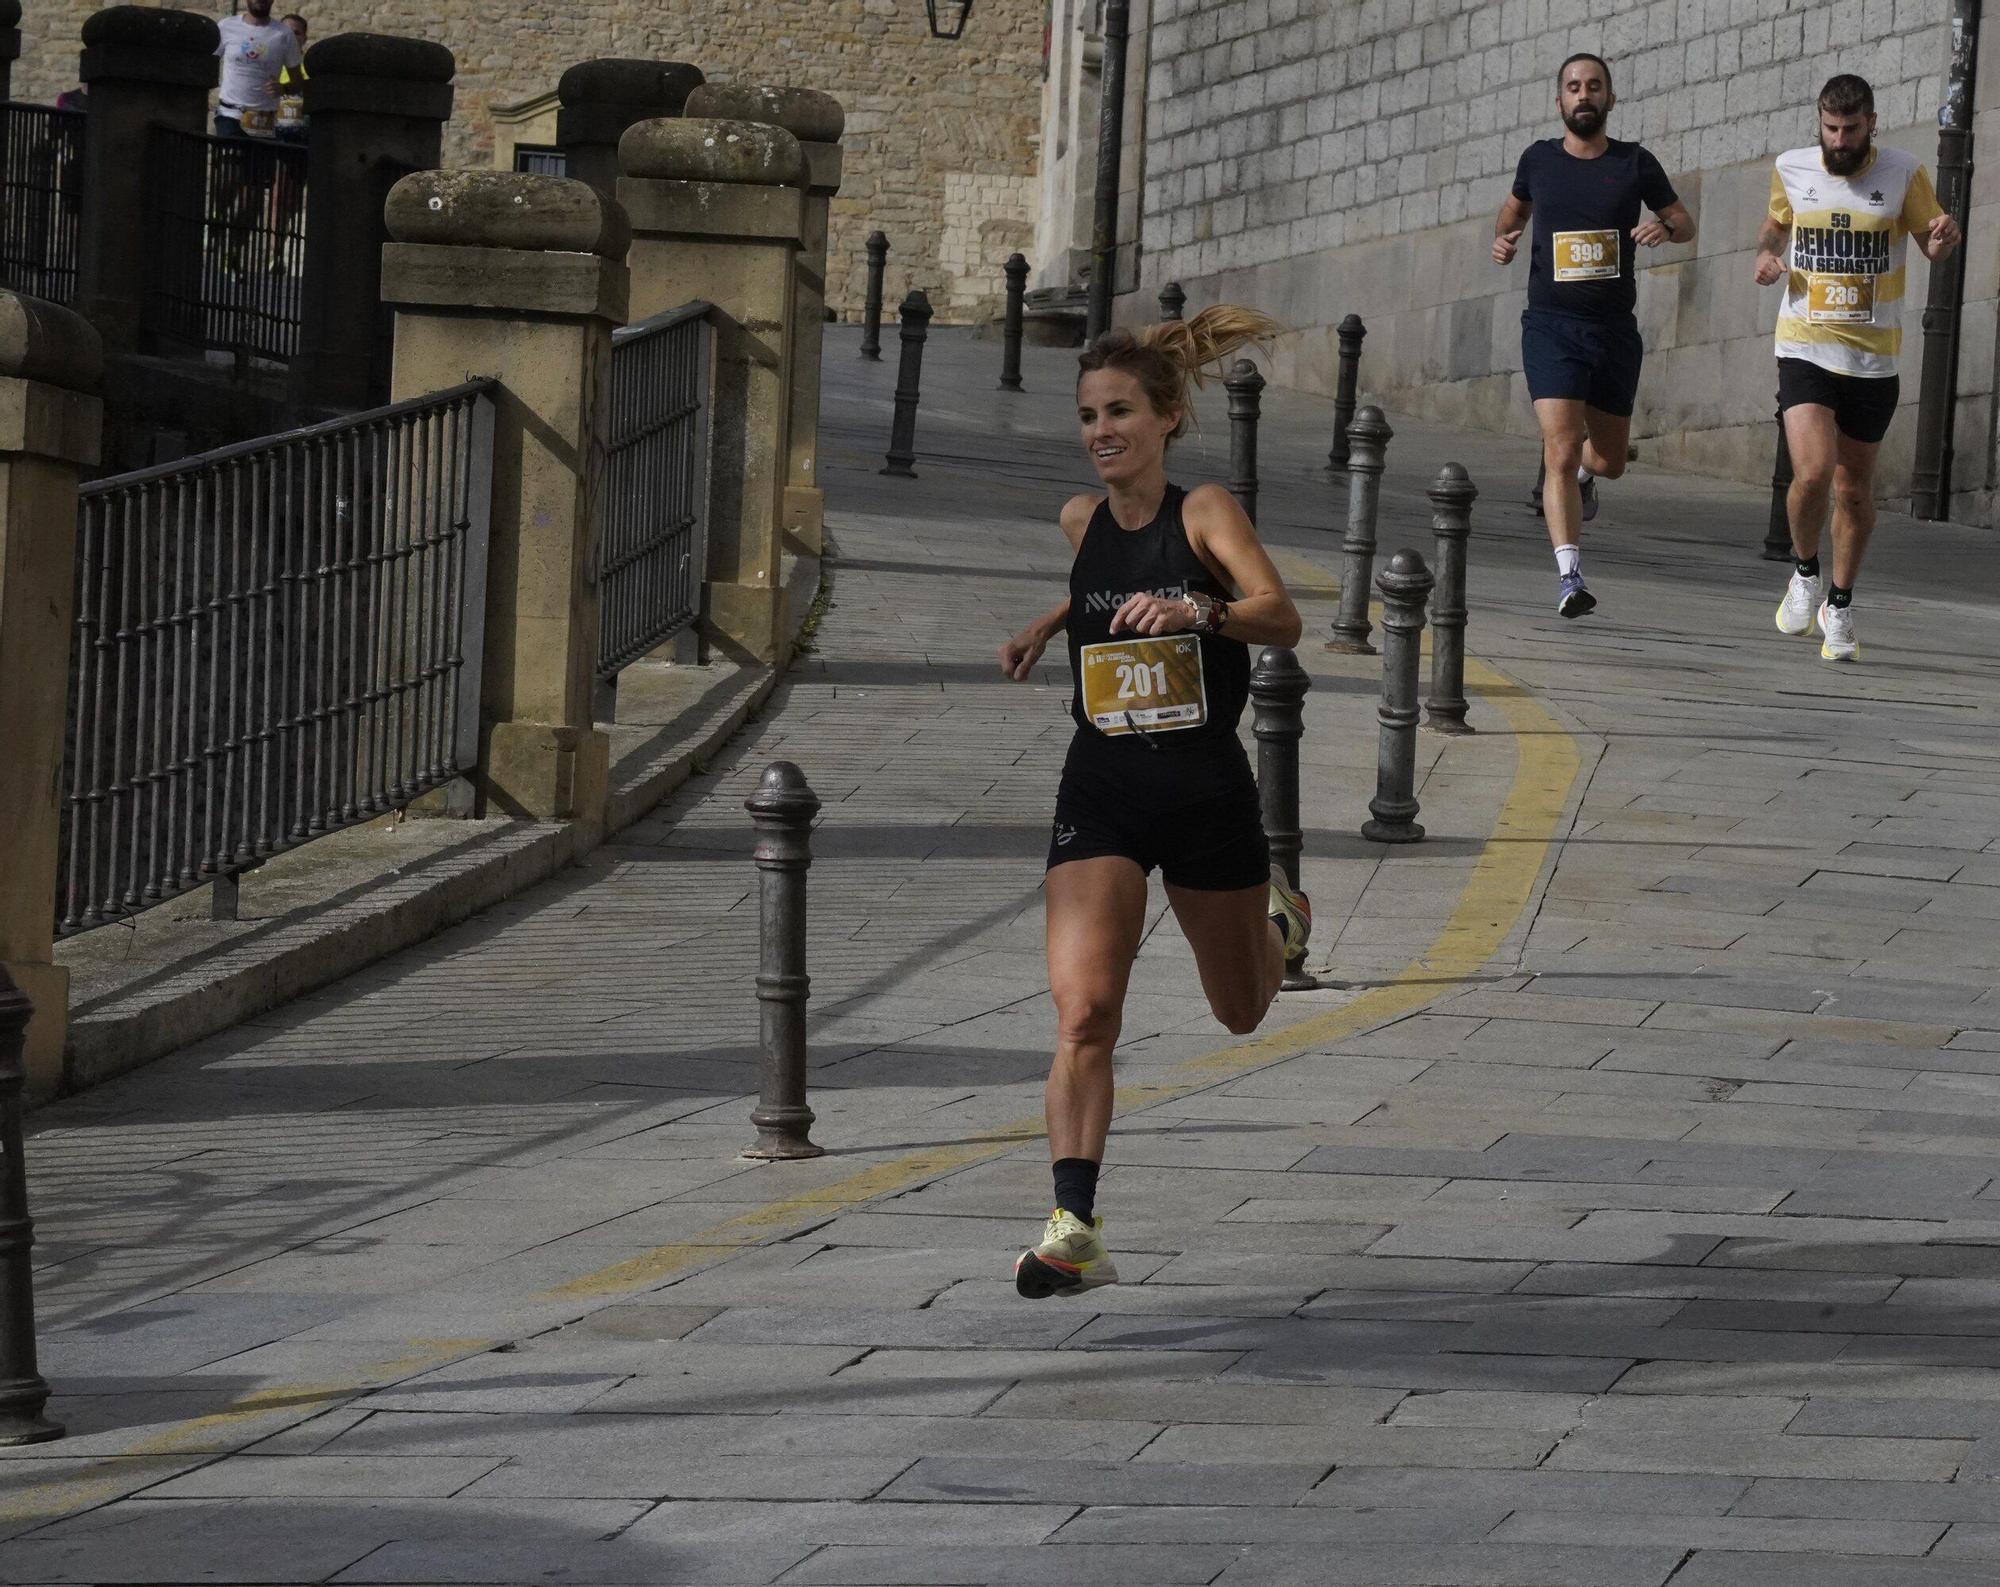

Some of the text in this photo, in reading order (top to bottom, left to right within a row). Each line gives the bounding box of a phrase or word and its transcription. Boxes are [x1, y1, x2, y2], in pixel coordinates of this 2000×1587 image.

[1831, 212, 1851, 229] 59
[1570, 242, 1604, 263] 398
[1794, 226, 1890, 259] BEHOBIA
[1794, 252, 1814, 273] SAN
[1824, 286, 1859, 305] 236
[1115, 661, 1168, 699] 201
